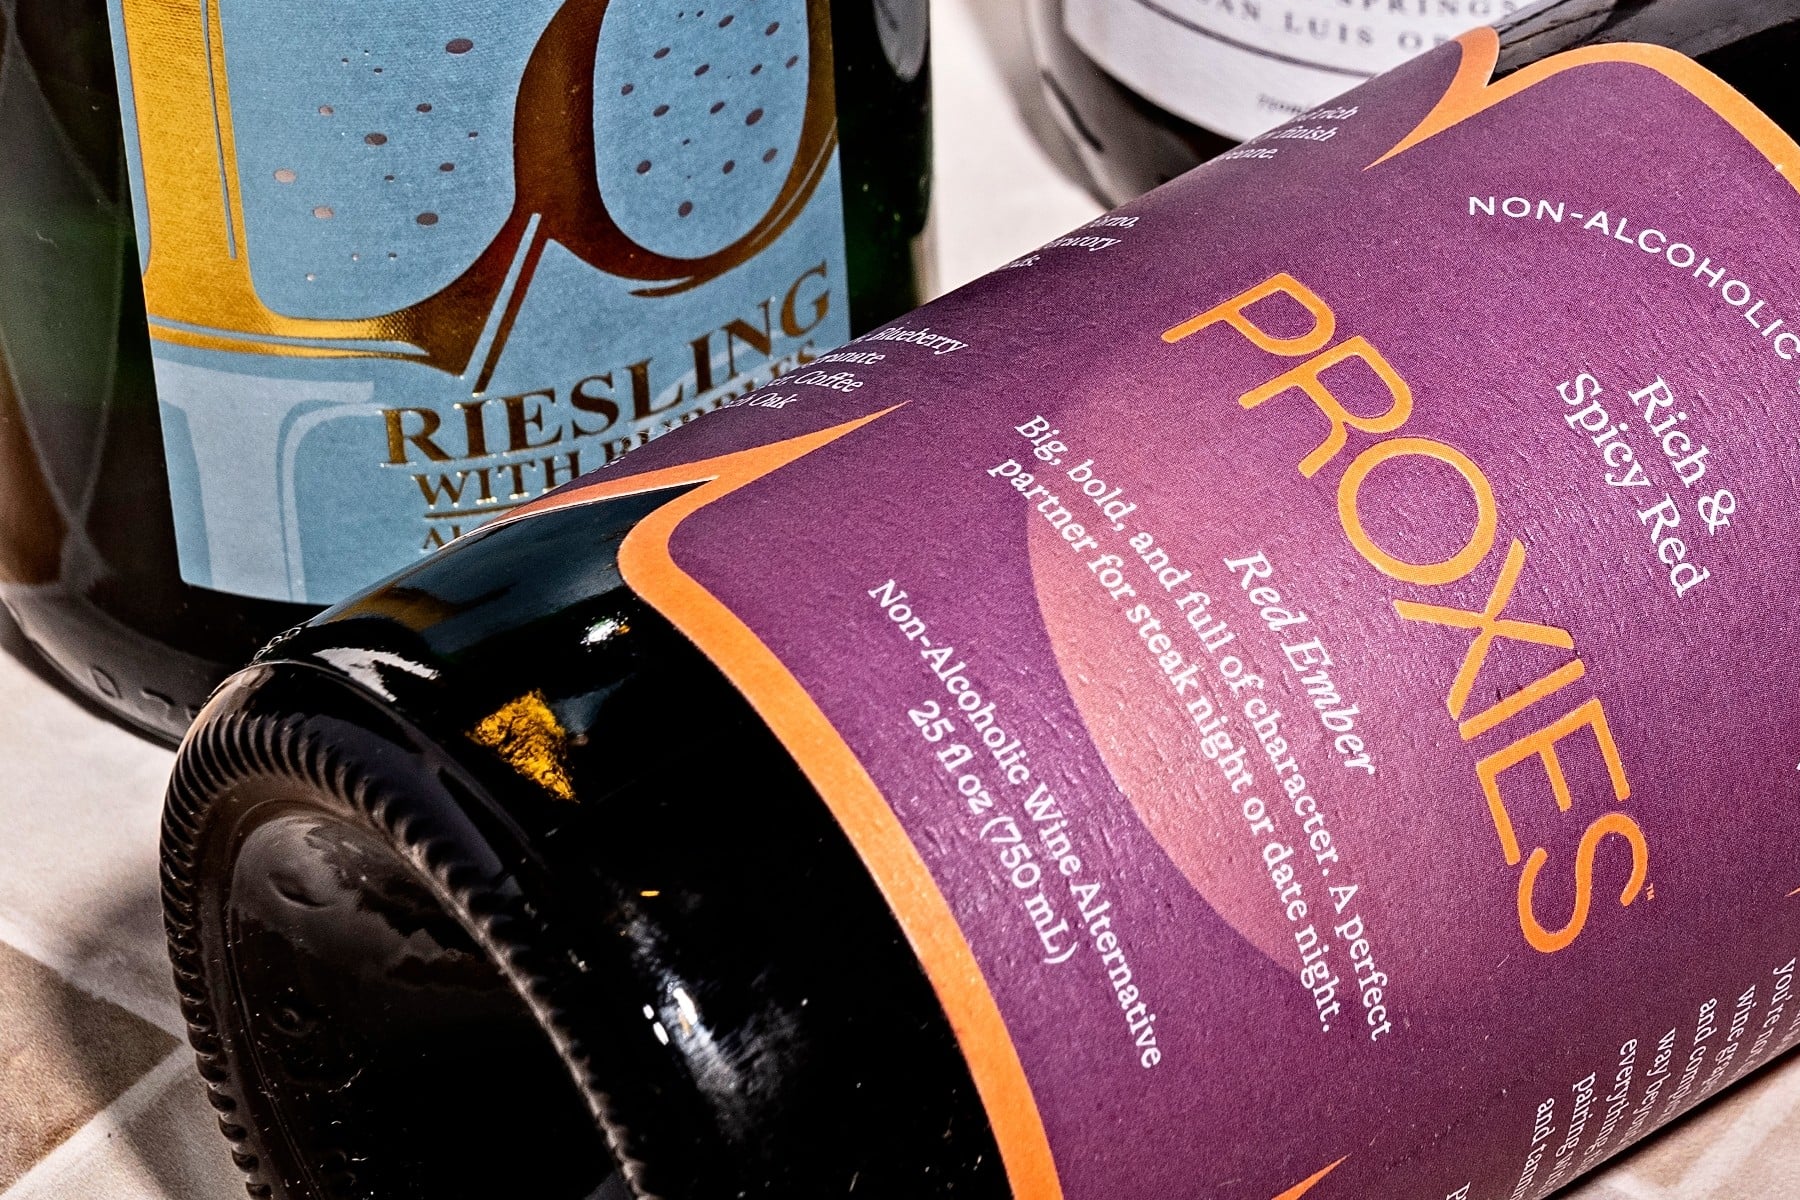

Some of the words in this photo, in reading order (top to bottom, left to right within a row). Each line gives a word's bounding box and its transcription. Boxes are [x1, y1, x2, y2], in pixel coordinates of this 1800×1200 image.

[1284, 10, 1374, 49] LUIS
[379, 260, 830, 467] RIESLING
[870, 327, 969, 355] Blueberry
[750, 393, 797, 409] Oak
[796, 370, 864, 392] Coffee
[1014, 415, 1069, 466] Big,
[1628, 375, 1708, 488] Rich
[1698, 489, 1737, 535] &
[411, 451, 581, 509] WITH
[1067, 459, 1138, 532] bold,
[1556, 372, 1651, 488] Spicy
[1638, 492, 1711, 598] Red
[1129, 530, 1192, 592] and
[1161, 273, 1649, 954] PROXIES
[1176, 590, 1237, 652] full
[1219, 654, 1265, 696] of
[1224, 550, 1308, 631] Red
[1280, 635, 1377, 776] Ember
[987, 458, 1098, 554] partner
[1087, 553, 1137, 602] for
[1127, 604, 1201, 696] steak
[1186, 699, 1255, 794] night
[1241, 797, 1275, 837] or
[1262, 841, 1309, 922] date
[1295, 924, 1342, 1034] night.
[1243, 698, 1341, 877] character.
[867, 578, 1031, 786] Non-Alcoholic
[1022, 783, 1083, 878] Wine
[1069, 880, 1163, 1070] Alternative
[908, 699, 956, 744] 25
[936, 743, 974, 775] fl
[957, 771, 996, 816] oz
[979, 814, 1043, 890] (750
[1023, 892, 1080, 965] mL)
[1329, 883, 1360, 915] A
[1334, 914, 1393, 1043] perfect
[1762, 958, 1797, 1028] you're
[1693, 997, 1718, 1046] and
[1726, 985, 1758, 1041] wine
[1646, 1028, 1677, 1078] way
[1531, 1098, 1556, 1147] and
[1555, 1072, 1598, 1157] pairing
[1584, 1038, 1639, 1155] everything
